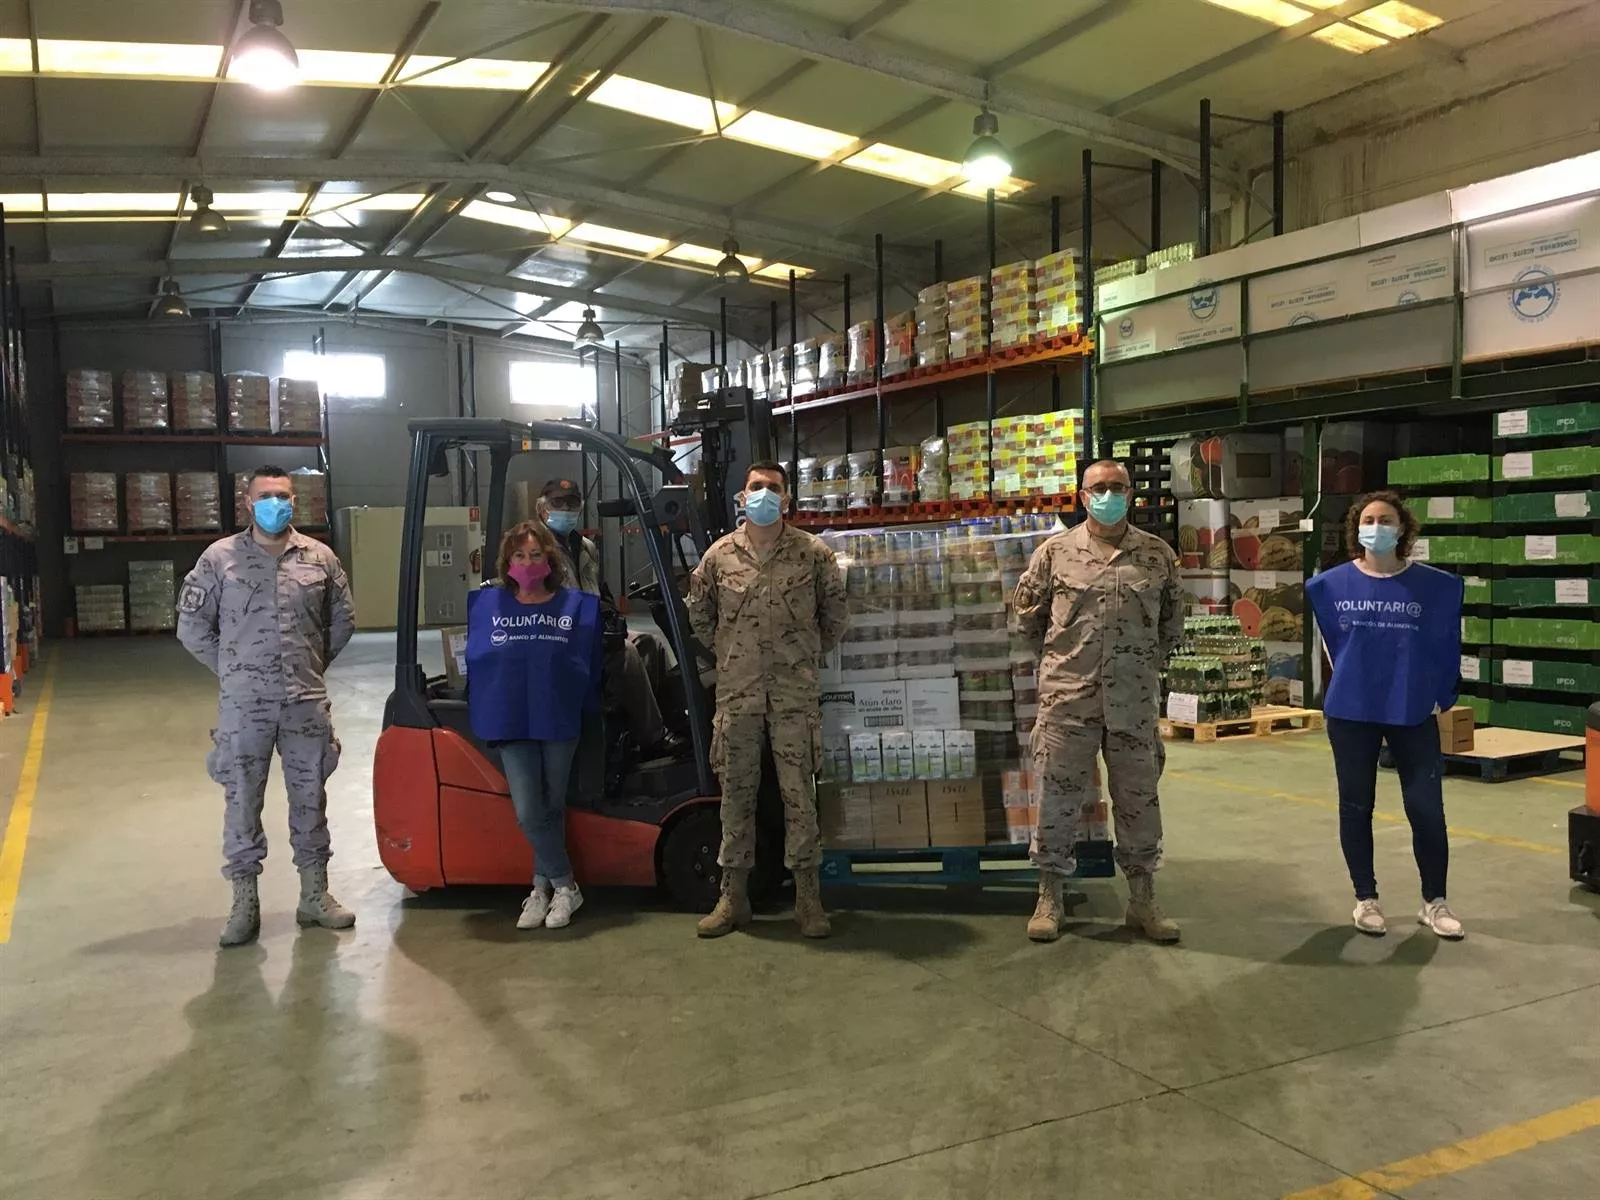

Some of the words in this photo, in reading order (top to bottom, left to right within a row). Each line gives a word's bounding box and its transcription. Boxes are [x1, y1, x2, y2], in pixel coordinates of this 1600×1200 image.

[1556, 418, 1575, 426] IFCO
[1334, 599, 1422, 618] VOLUNTARI@
[491, 613, 573, 631] VOLUNTARI@
[1556, 635, 1576, 644] IFCO
[1556, 677, 1575, 686] IFCO
[880, 697, 903, 706] claro
[1553, 719, 1572, 728] IFCO
